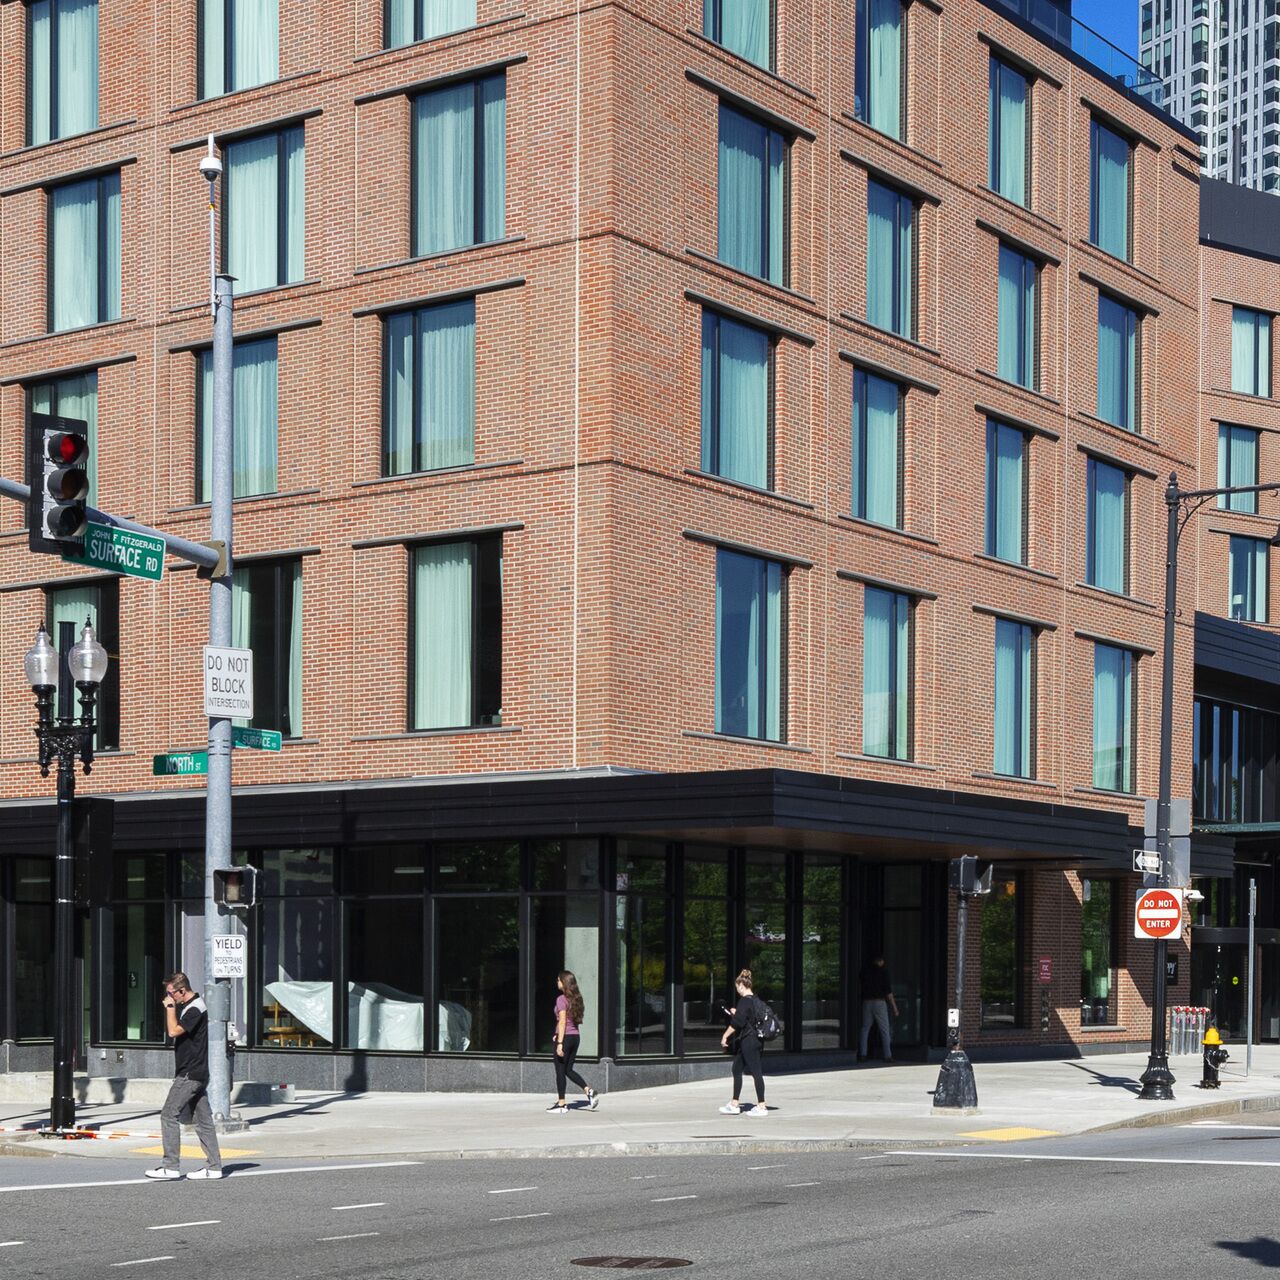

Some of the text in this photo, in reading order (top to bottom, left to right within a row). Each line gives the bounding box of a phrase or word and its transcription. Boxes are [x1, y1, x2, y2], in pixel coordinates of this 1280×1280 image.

[91, 529, 162, 552] JOHN F FITZGERALD
[89, 539, 158, 572] SURFACE RD
[208, 655, 249, 673] DO NOT
[211, 677, 246, 694] BLOCK
[208, 697, 250, 709] INTERSECTION
[242, 734, 271, 748] SURFACE
[165, 756, 202, 773] NORTH ST
[1143, 899, 1173, 908] DO NOT
[1146, 920, 1171, 928] ENTER
[215, 938, 243, 950] YIELD
[224, 965, 242, 974] TURNS
